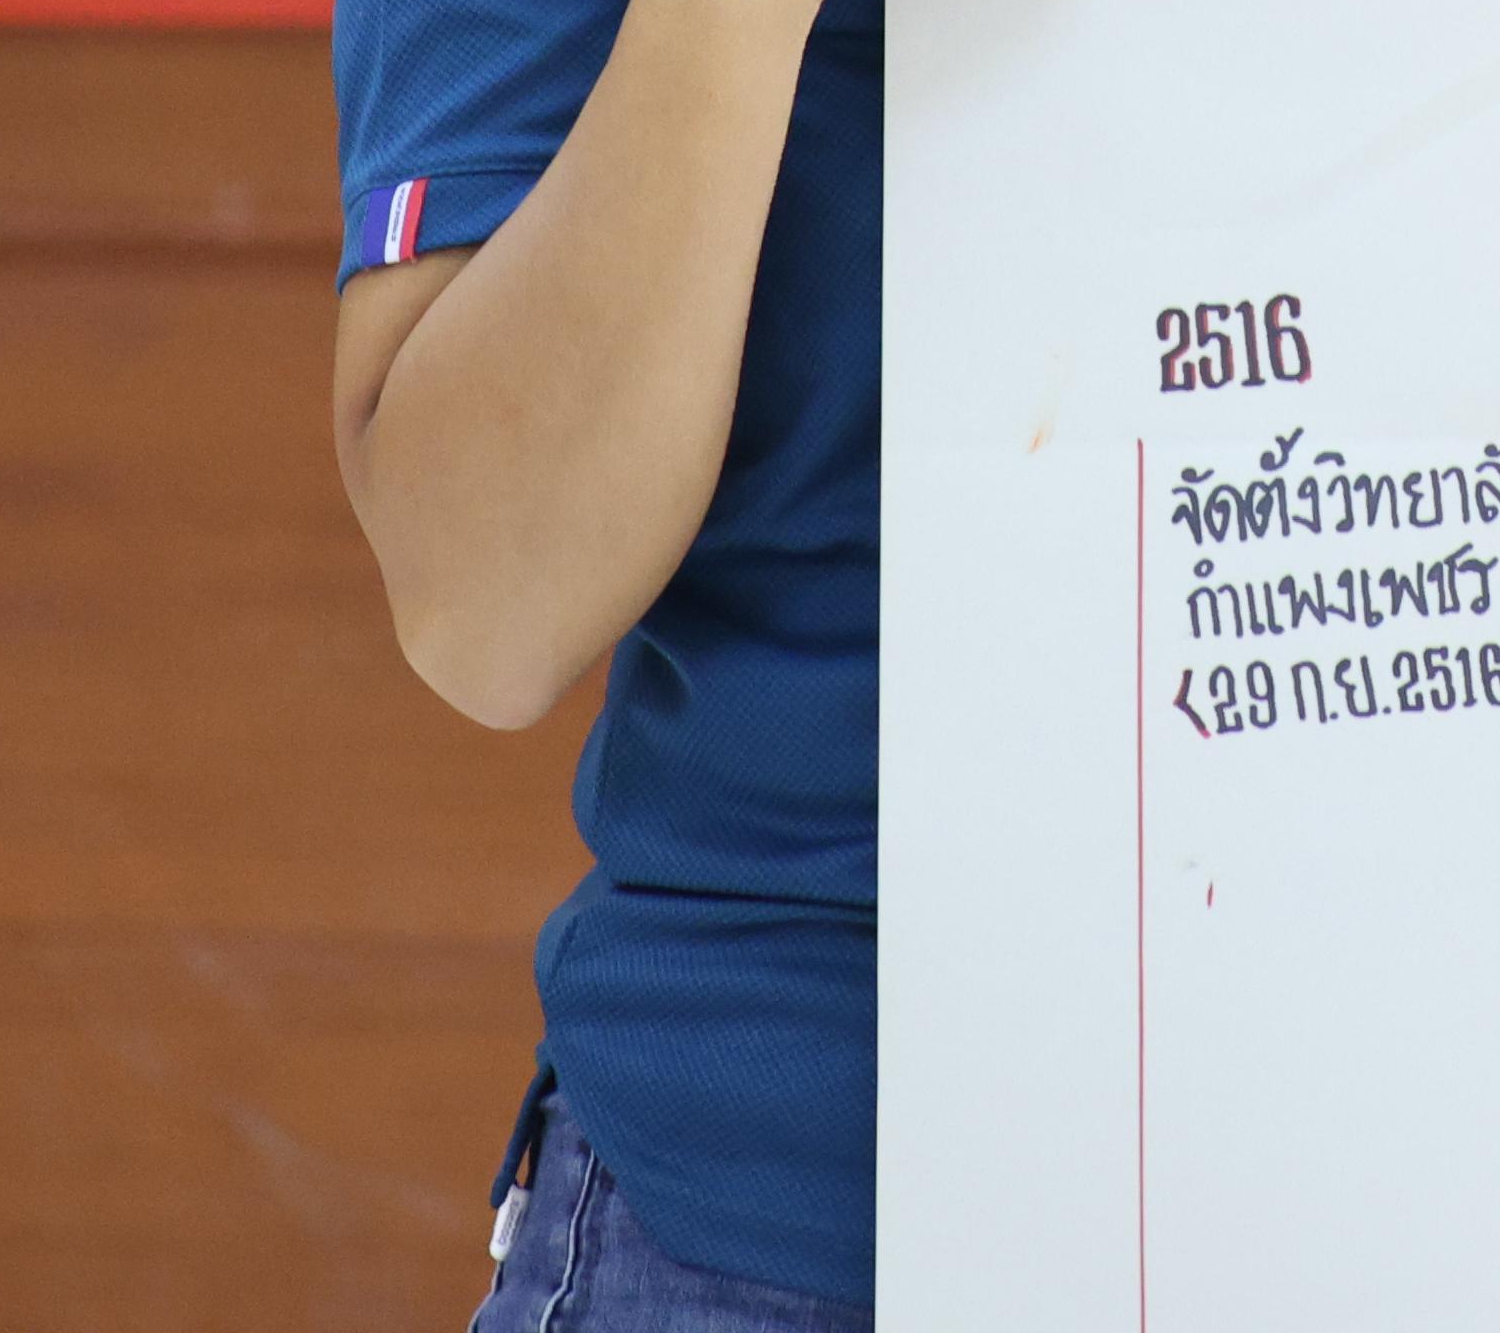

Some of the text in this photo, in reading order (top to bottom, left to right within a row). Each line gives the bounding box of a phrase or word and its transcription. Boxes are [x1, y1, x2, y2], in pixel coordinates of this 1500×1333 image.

[1156, 294, 1311, 393] 2516
[1186, 543, 1498, 638] กำแพงเพชร
